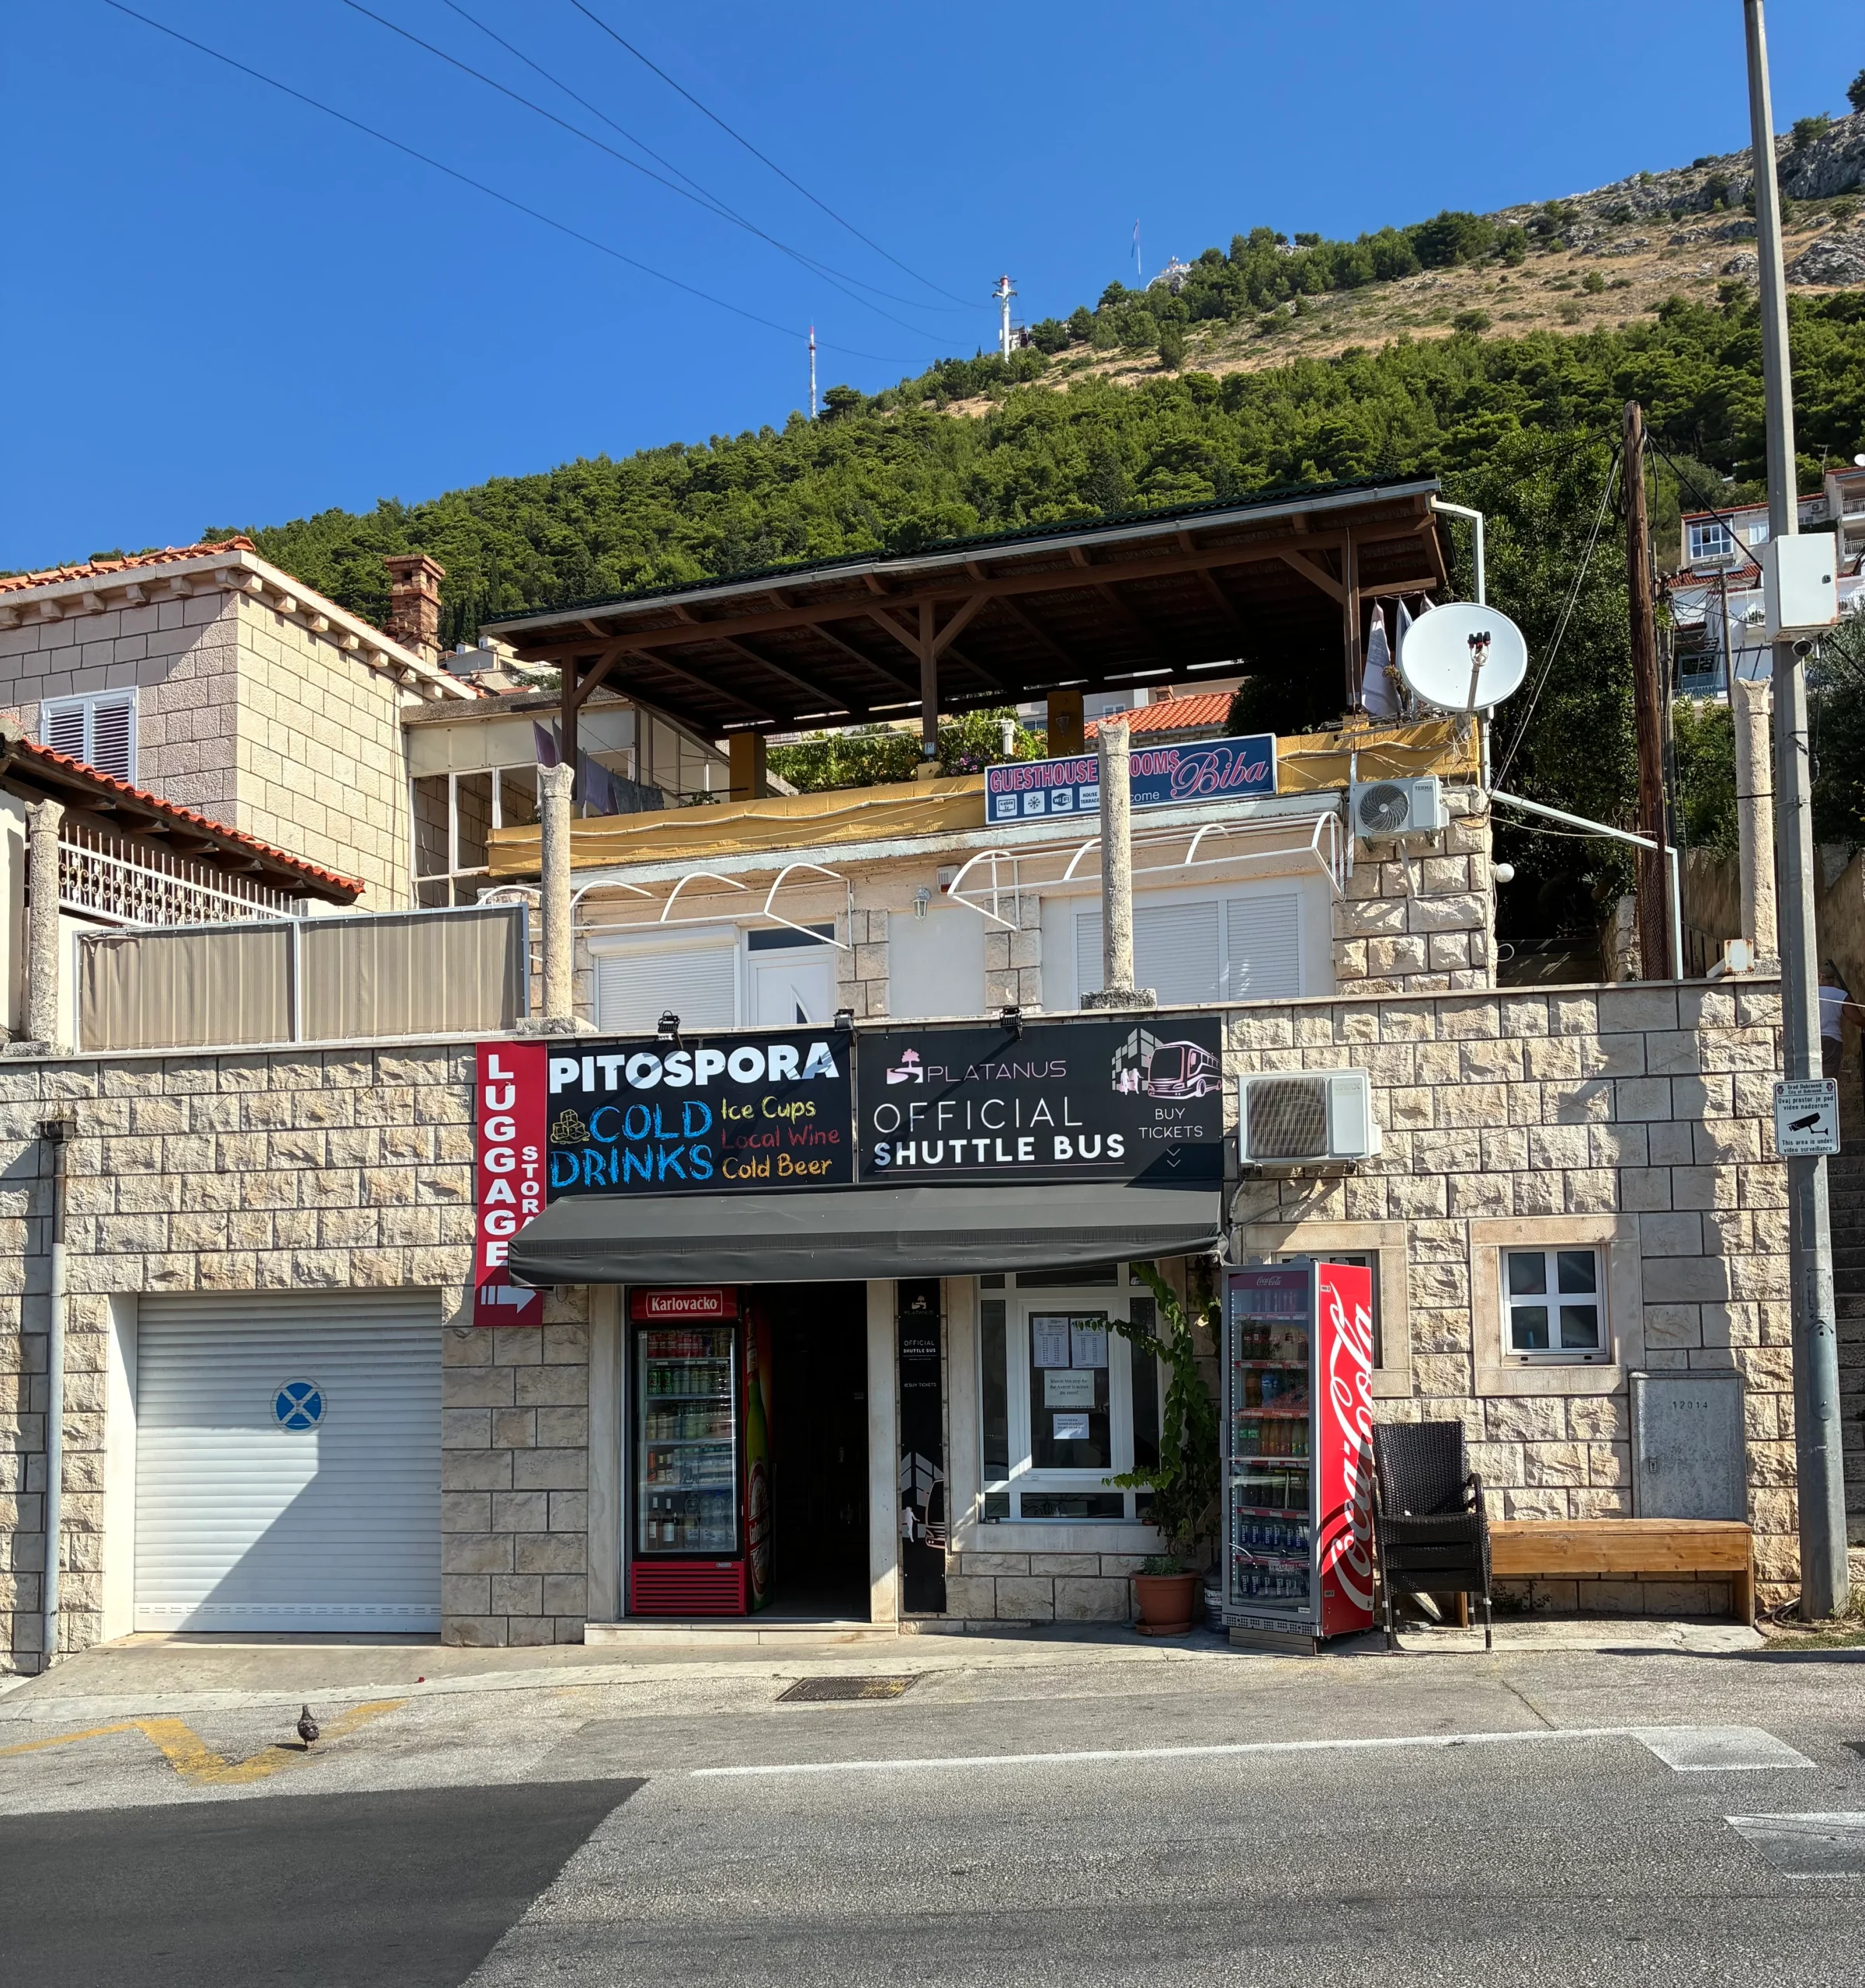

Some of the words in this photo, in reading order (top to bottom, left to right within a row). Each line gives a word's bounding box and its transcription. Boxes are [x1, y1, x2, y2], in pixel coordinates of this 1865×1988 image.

[990, 759, 1098, 794] GUESTHOUSE
[1130, 749, 1180, 777] OOMS
[1170, 748, 1269, 800] Biba
[549, 1042, 839, 1093] PITOSPORA
[927, 1060, 1067, 1083] PLATANUS
[589, 1100, 713, 1143] COLD
[721, 1097, 754, 1121] Ice
[761, 1095, 817, 1124] Cups
[873, 1096, 1082, 1134] OFFICIAL
[1155, 1107, 1186, 1121] BUY
[721, 1126, 780, 1150] Local
[787, 1124, 840, 1146] Wine
[1137, 1125, 1203, 1139] TICKETS
[484, 1054, 516, 1267] LUGGAGE
[873, 1137, 1035, 1166] SHUTTLE
[1054, 1134, 1125, 1161] BUS
[550, 1144, 714, 1188] DRINKS
[722, 1153, 769, 1180] Cold
[777, 1153, 832, 1178] Beer
[651, 1296, 718, 1312] Karlovačko
[1672, 1400, 1708, 1409] 12014
